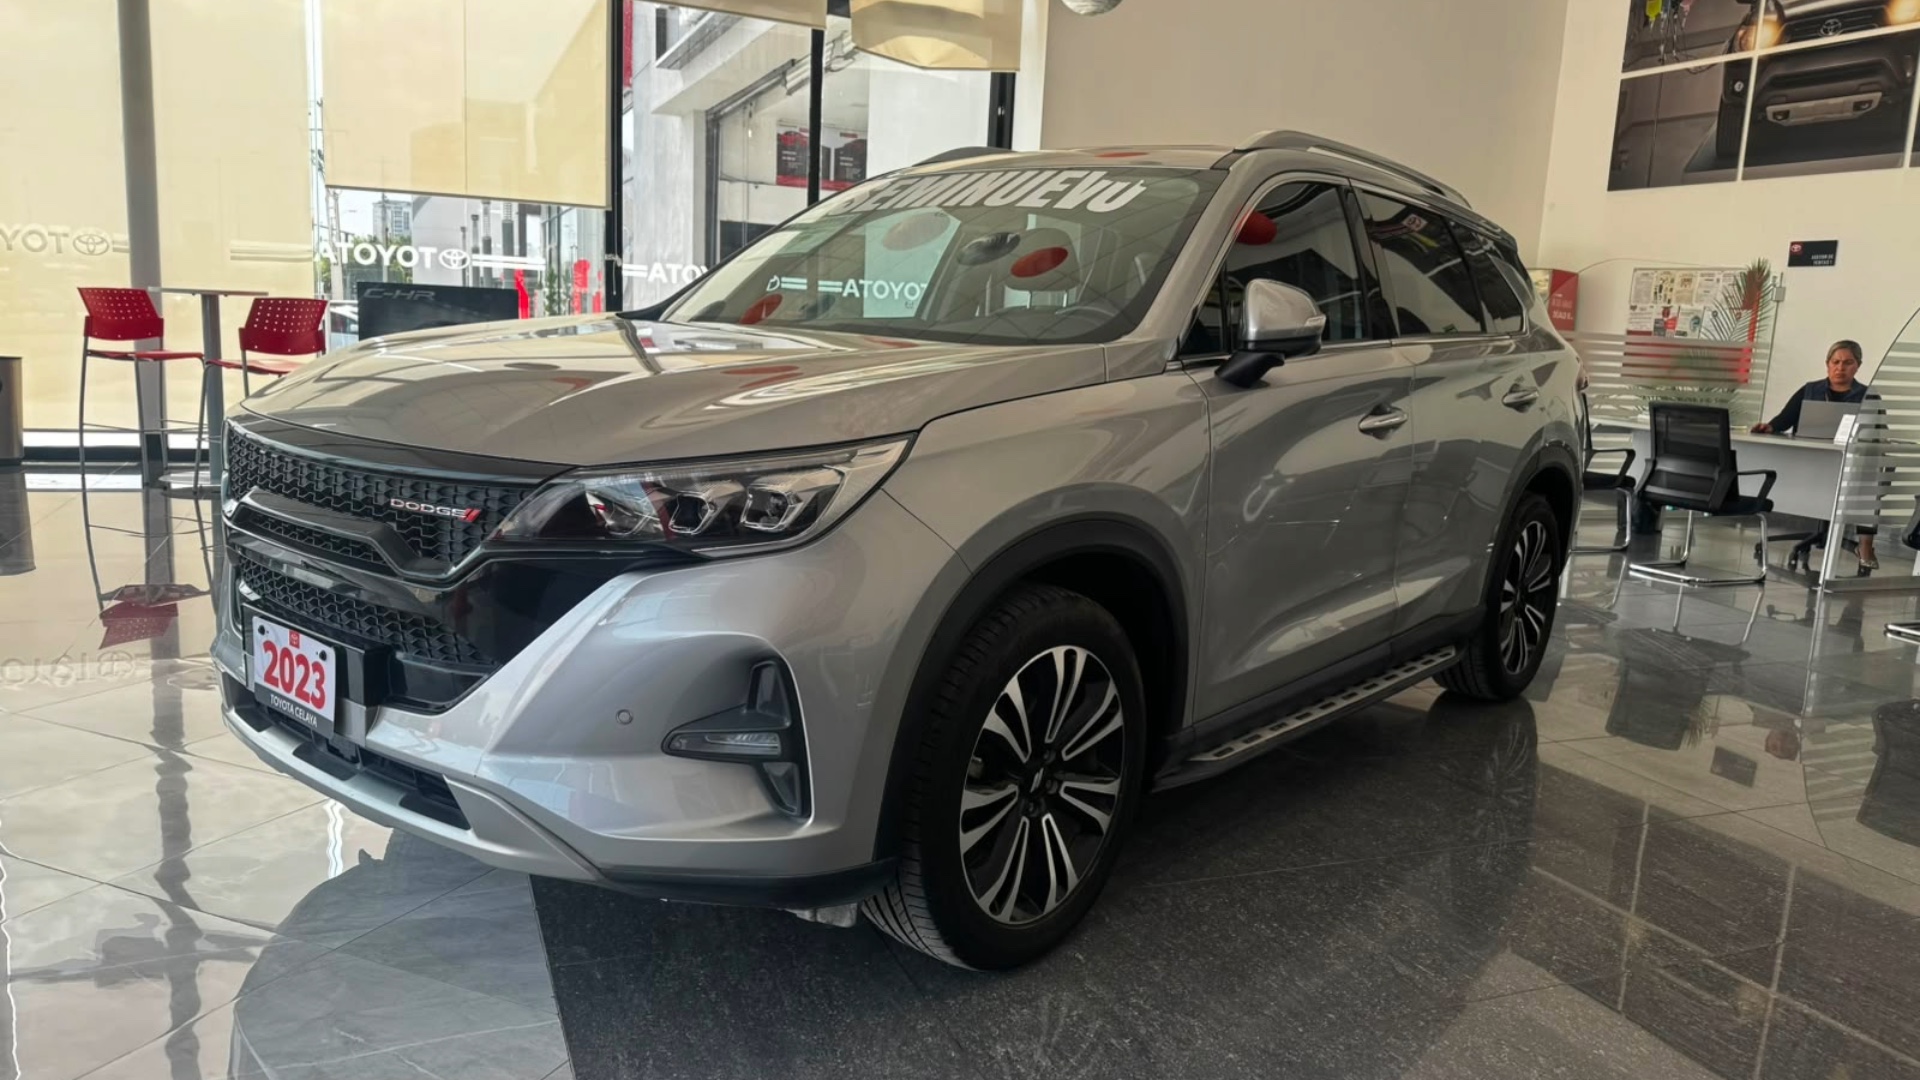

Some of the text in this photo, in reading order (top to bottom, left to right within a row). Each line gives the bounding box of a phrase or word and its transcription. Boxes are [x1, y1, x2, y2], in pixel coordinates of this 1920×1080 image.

[363, 287, 437, 300] C-HR
[390, 498, 467, 518] DODGE
[263, 640, 326, 710] 2023
[270, 694, 318, 728] TOYOTA CELAYA
